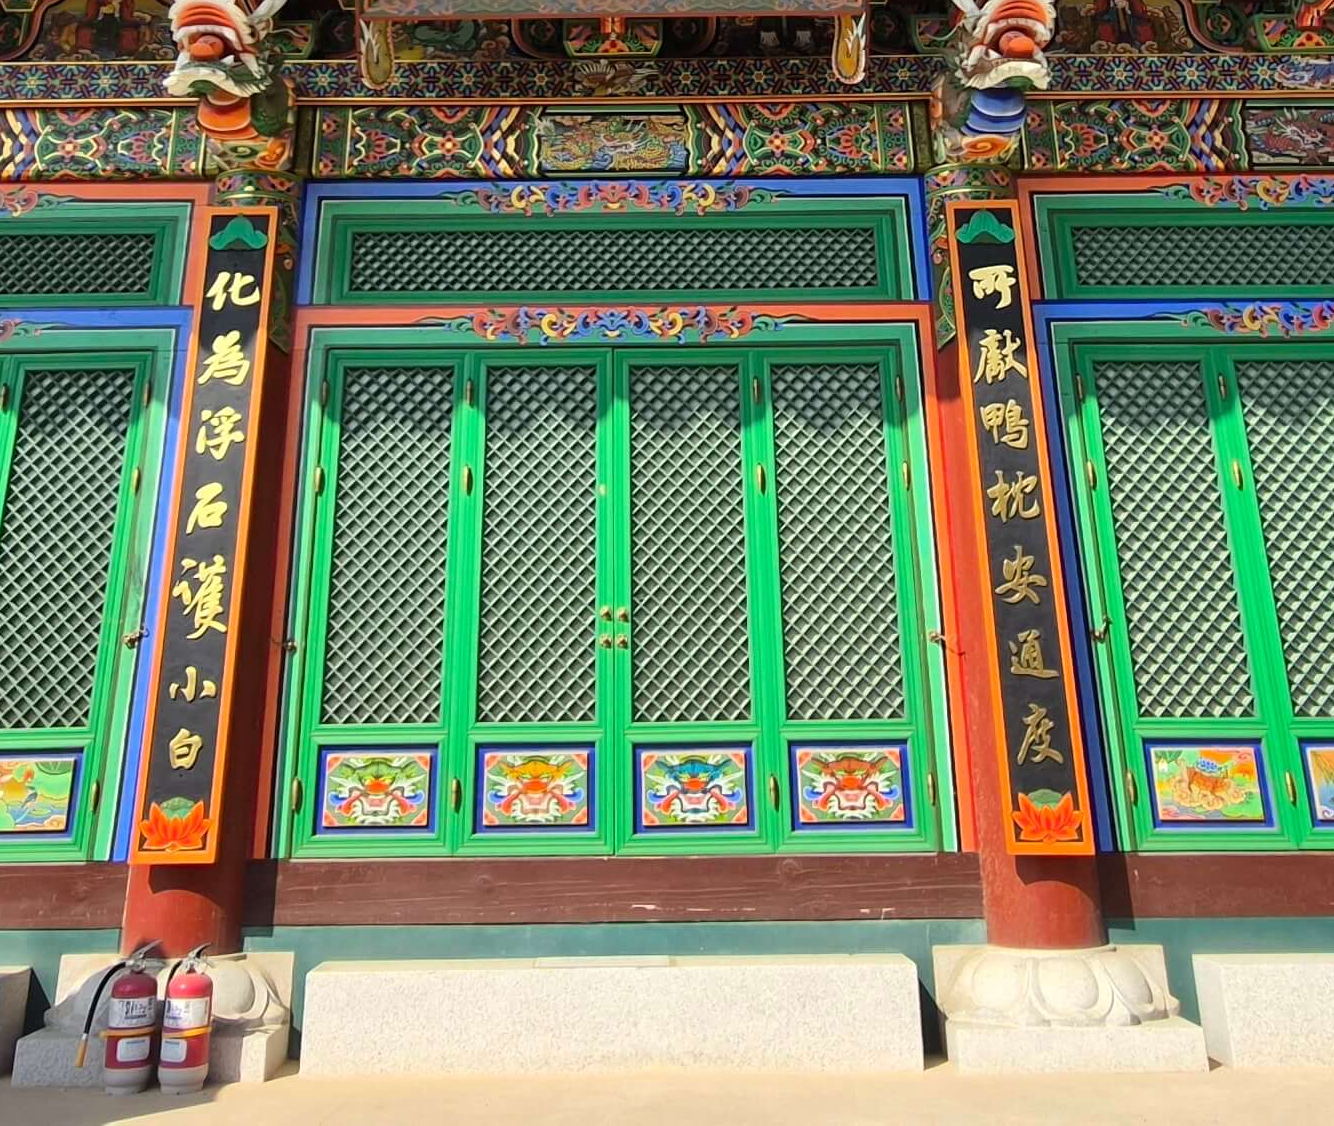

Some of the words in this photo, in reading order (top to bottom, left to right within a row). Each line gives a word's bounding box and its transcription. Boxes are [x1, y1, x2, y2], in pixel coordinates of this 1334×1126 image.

[168, 270, 261, 771] 化為浮石護小白
[968, 263, 1064, 765] 所獻鴨枕安通度
